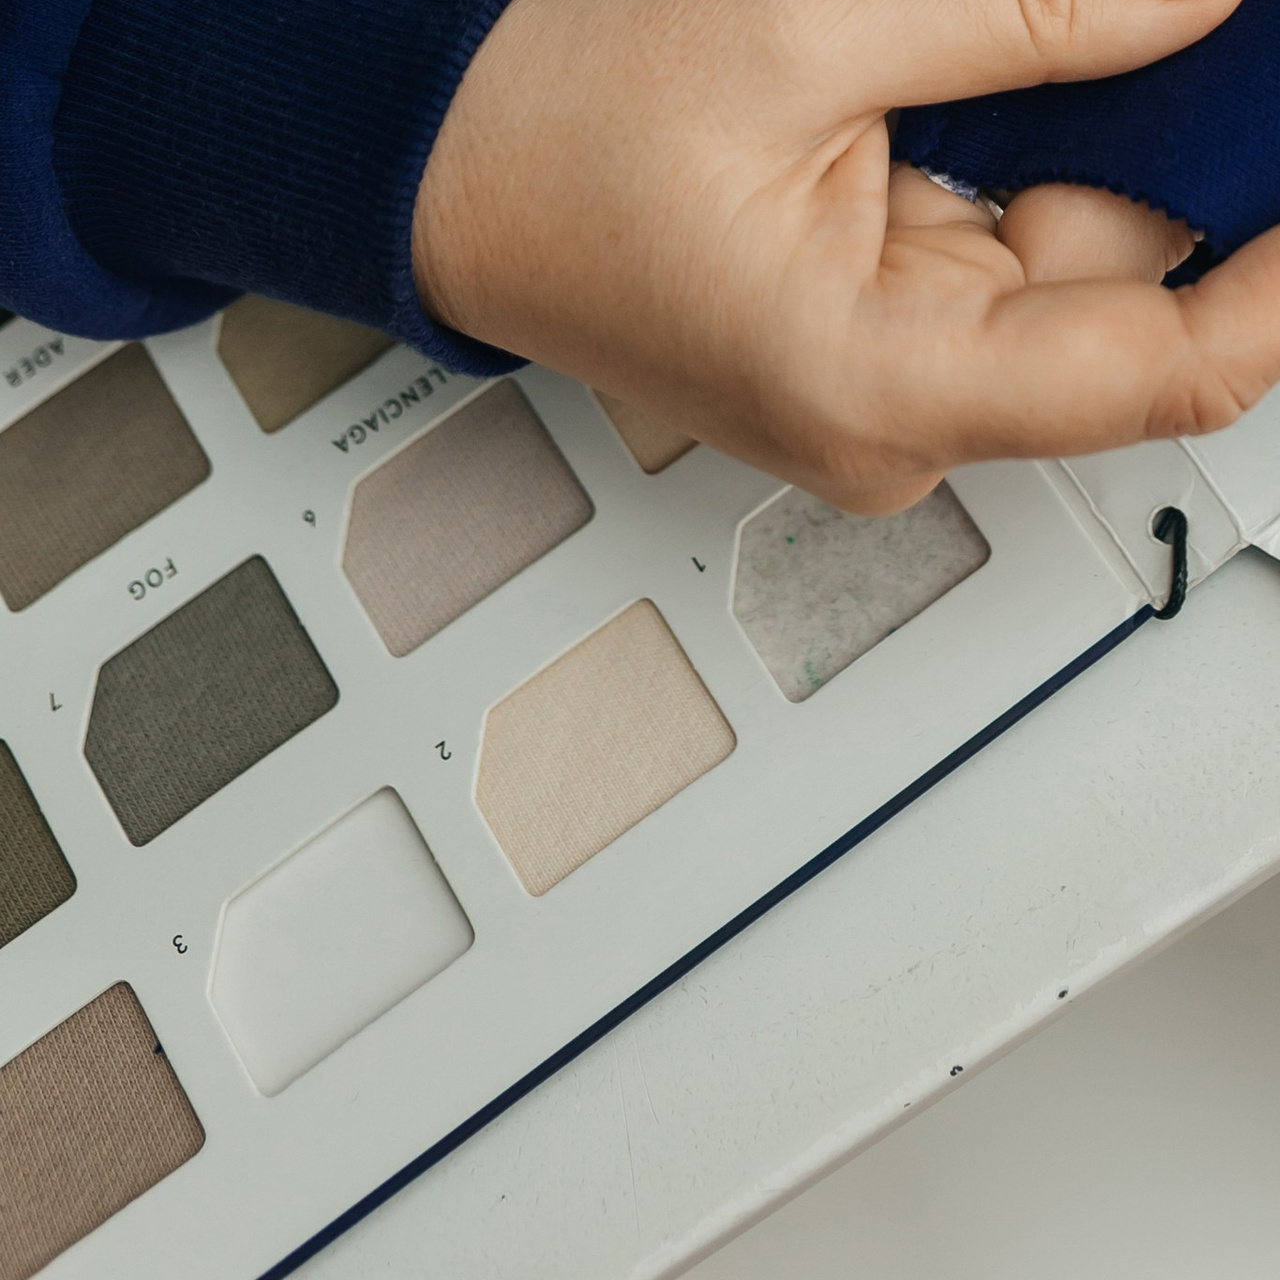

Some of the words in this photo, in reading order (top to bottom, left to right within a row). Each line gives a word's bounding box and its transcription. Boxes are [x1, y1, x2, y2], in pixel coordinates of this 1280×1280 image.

[331, 366, 448, 453] LENCIAGA
[301, 509, 316, 528] 6
[127, 557, 179, 601] FOG
[434, 740, 453, 761] 2
[172, 934, 189, 955] 3
